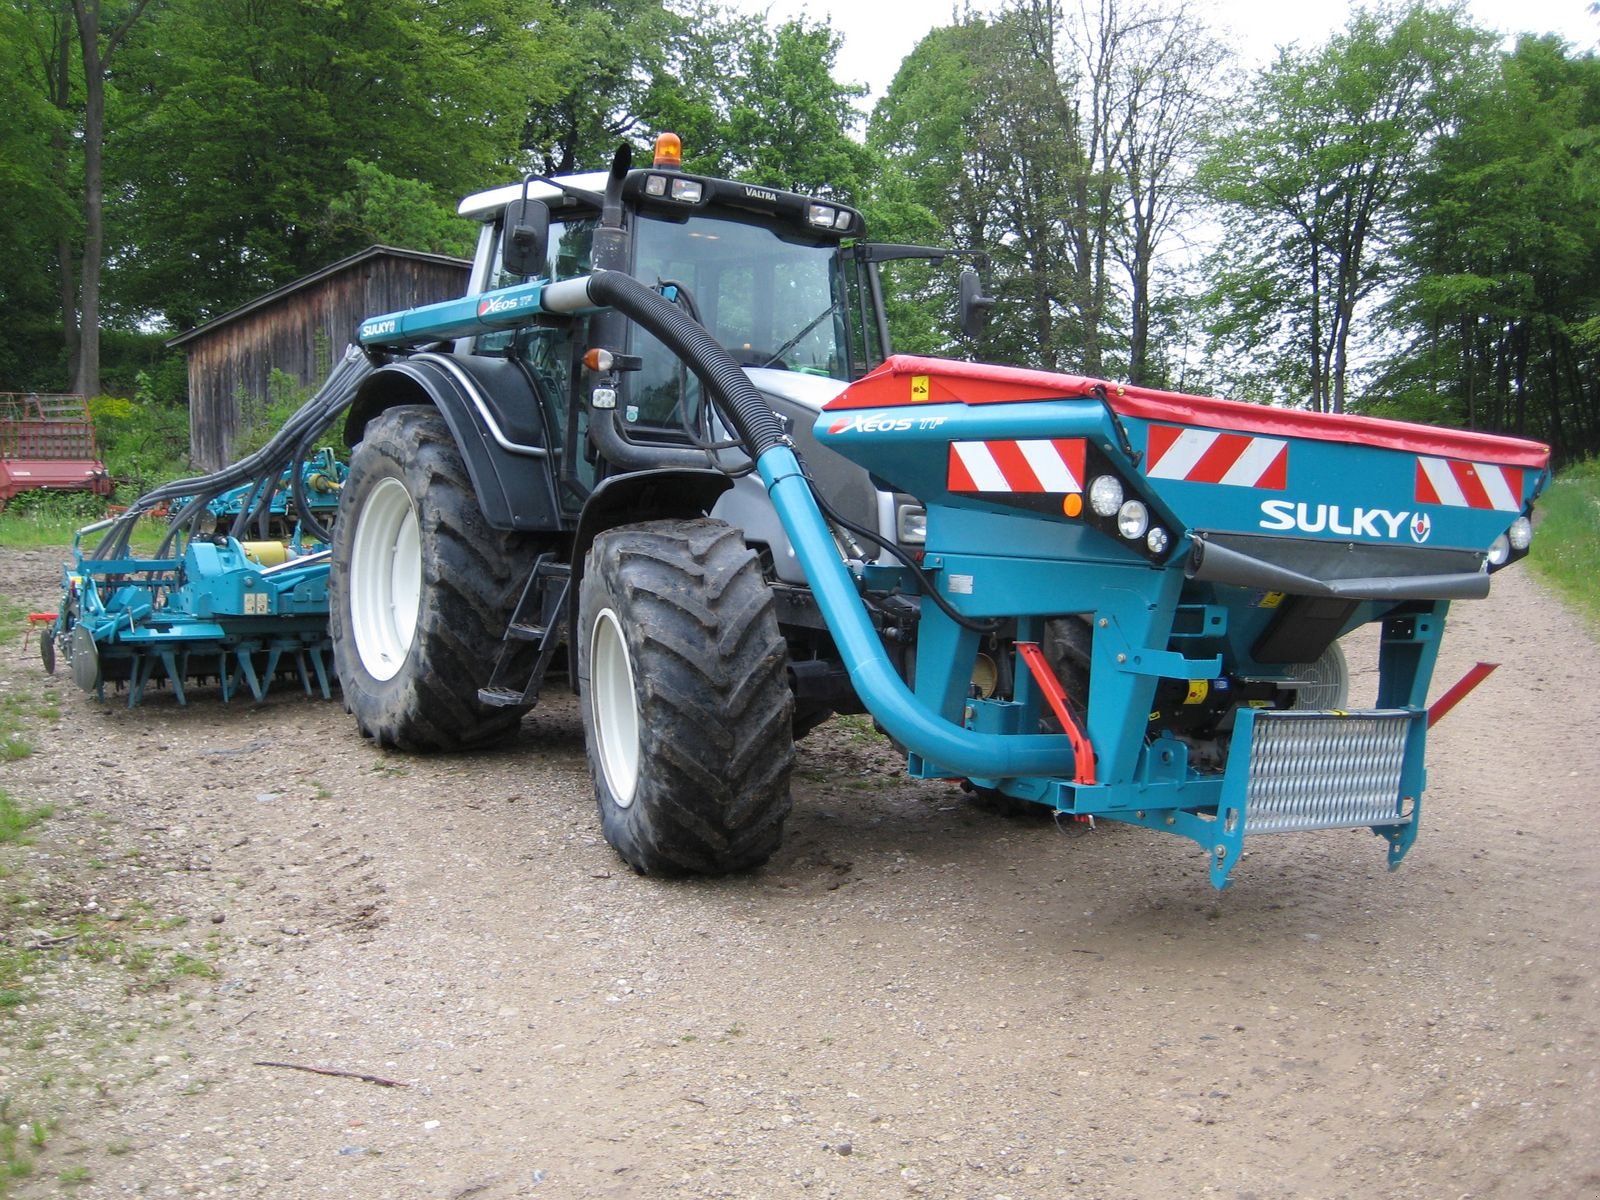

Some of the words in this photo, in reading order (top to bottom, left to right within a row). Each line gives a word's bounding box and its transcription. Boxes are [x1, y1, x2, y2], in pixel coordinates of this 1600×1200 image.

[745, 186, 777, 201] VALTRA
[362, 321, 391, 337] SULKY
[1259, 499, 1411, 538] SULKY
